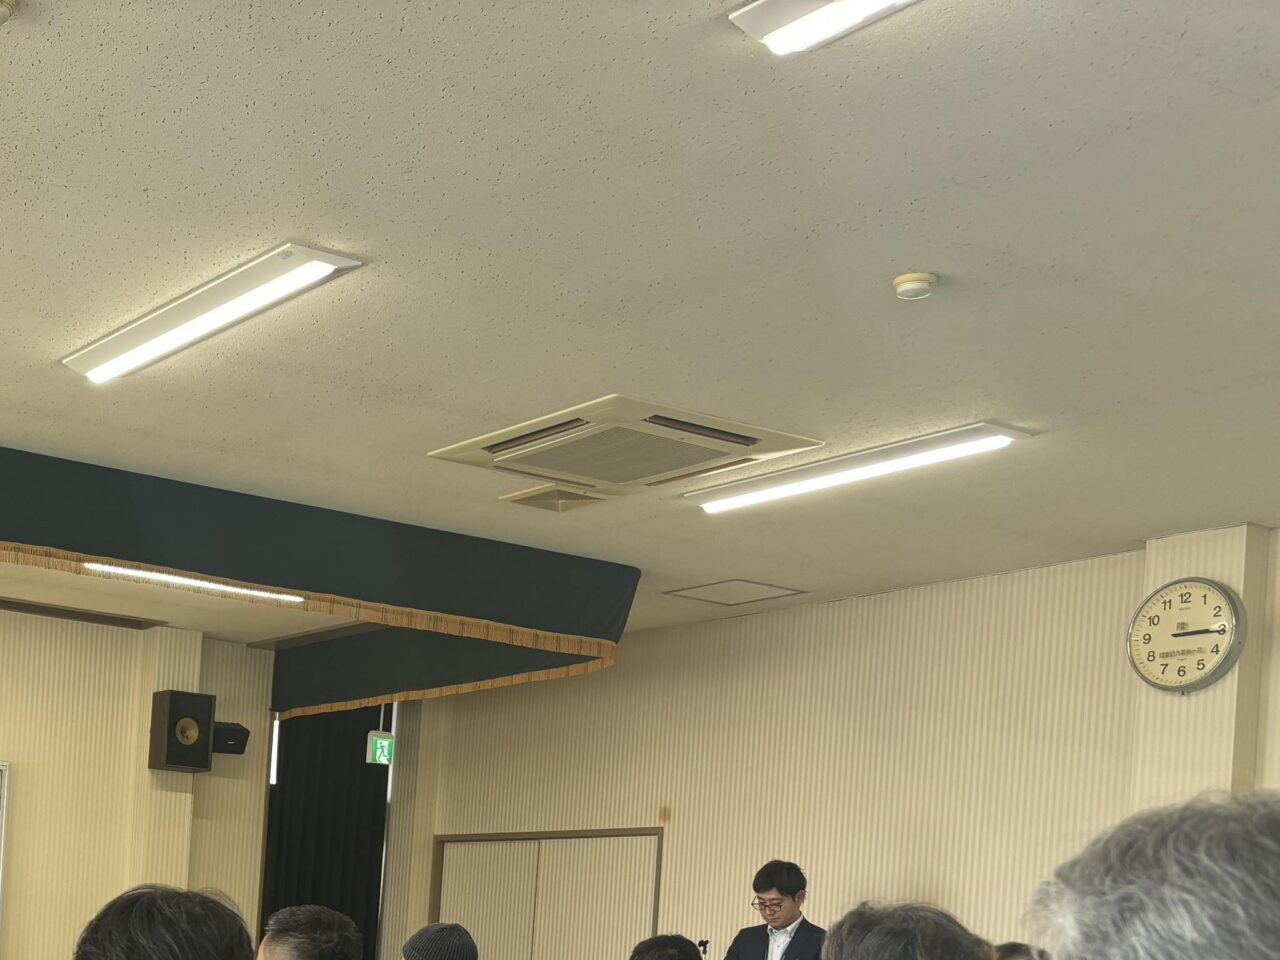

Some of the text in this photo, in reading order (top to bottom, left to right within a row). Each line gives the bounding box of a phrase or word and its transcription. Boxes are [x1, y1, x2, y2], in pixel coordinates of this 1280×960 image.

[1179, 592, 1191, 604] 12
[1202, 594, 1207, 605] 1
[1162, 599, 1172, 610] 11
[1213, 605, 1222, 617] 2
[1147, 614, 1160, 626] 10
[1142, 633, 1151, 644] 9
[1210, 644, 1220, 655] 4
[1147, 651, 1155, 662] 8
[1160, 663, 1168, 675] 7
[1196, 659, 1205, 670] 5
[1177, 666, 1186, 677] 6
